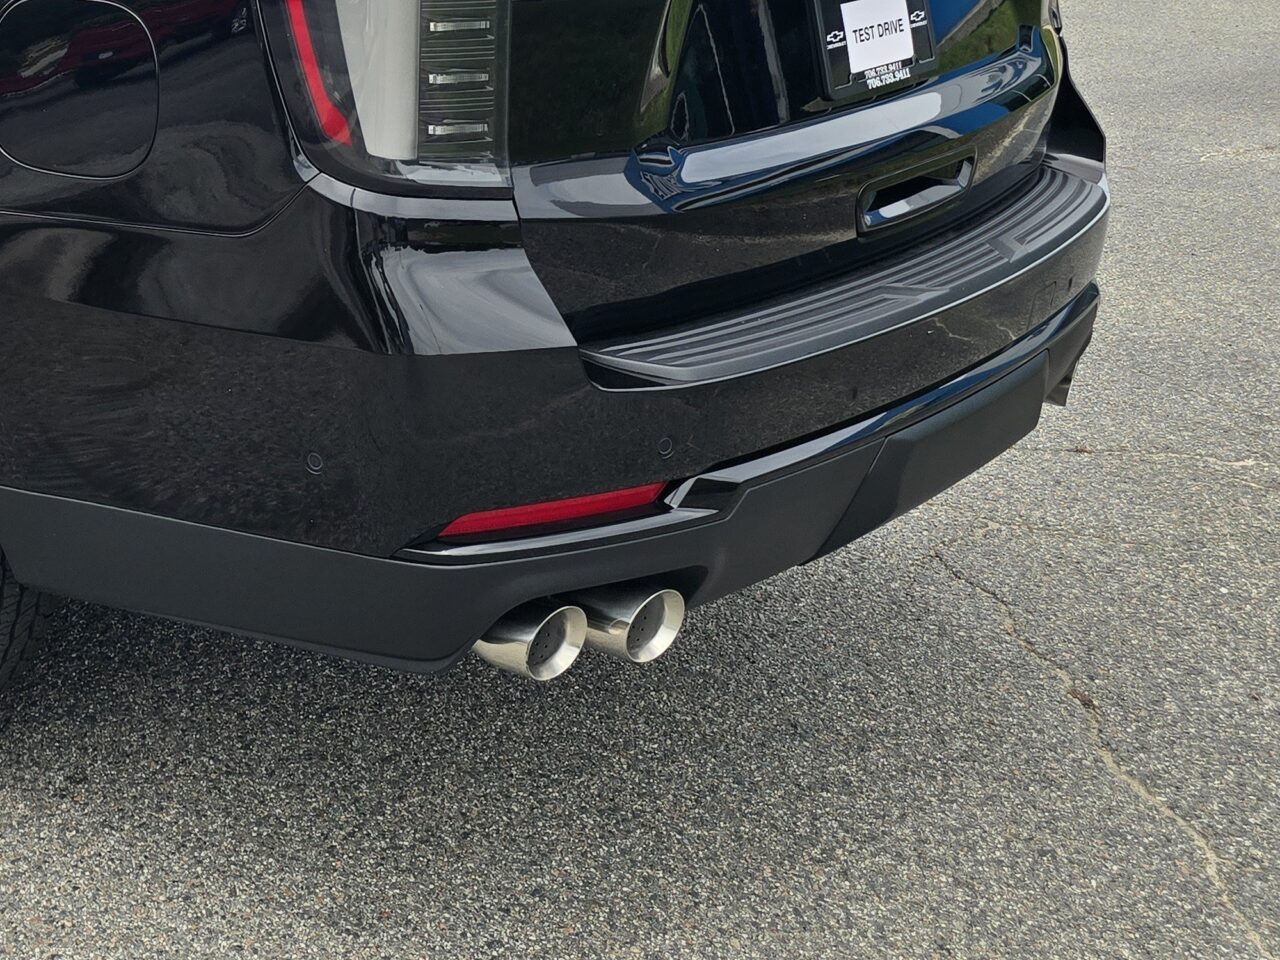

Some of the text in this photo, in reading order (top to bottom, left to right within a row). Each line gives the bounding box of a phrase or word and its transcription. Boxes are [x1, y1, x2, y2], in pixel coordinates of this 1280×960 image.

[852, 25, 875, 44] TEST
[878, 18, 905, 38] DRIVE
[866, 67, 911, 90] 706.733.9411
